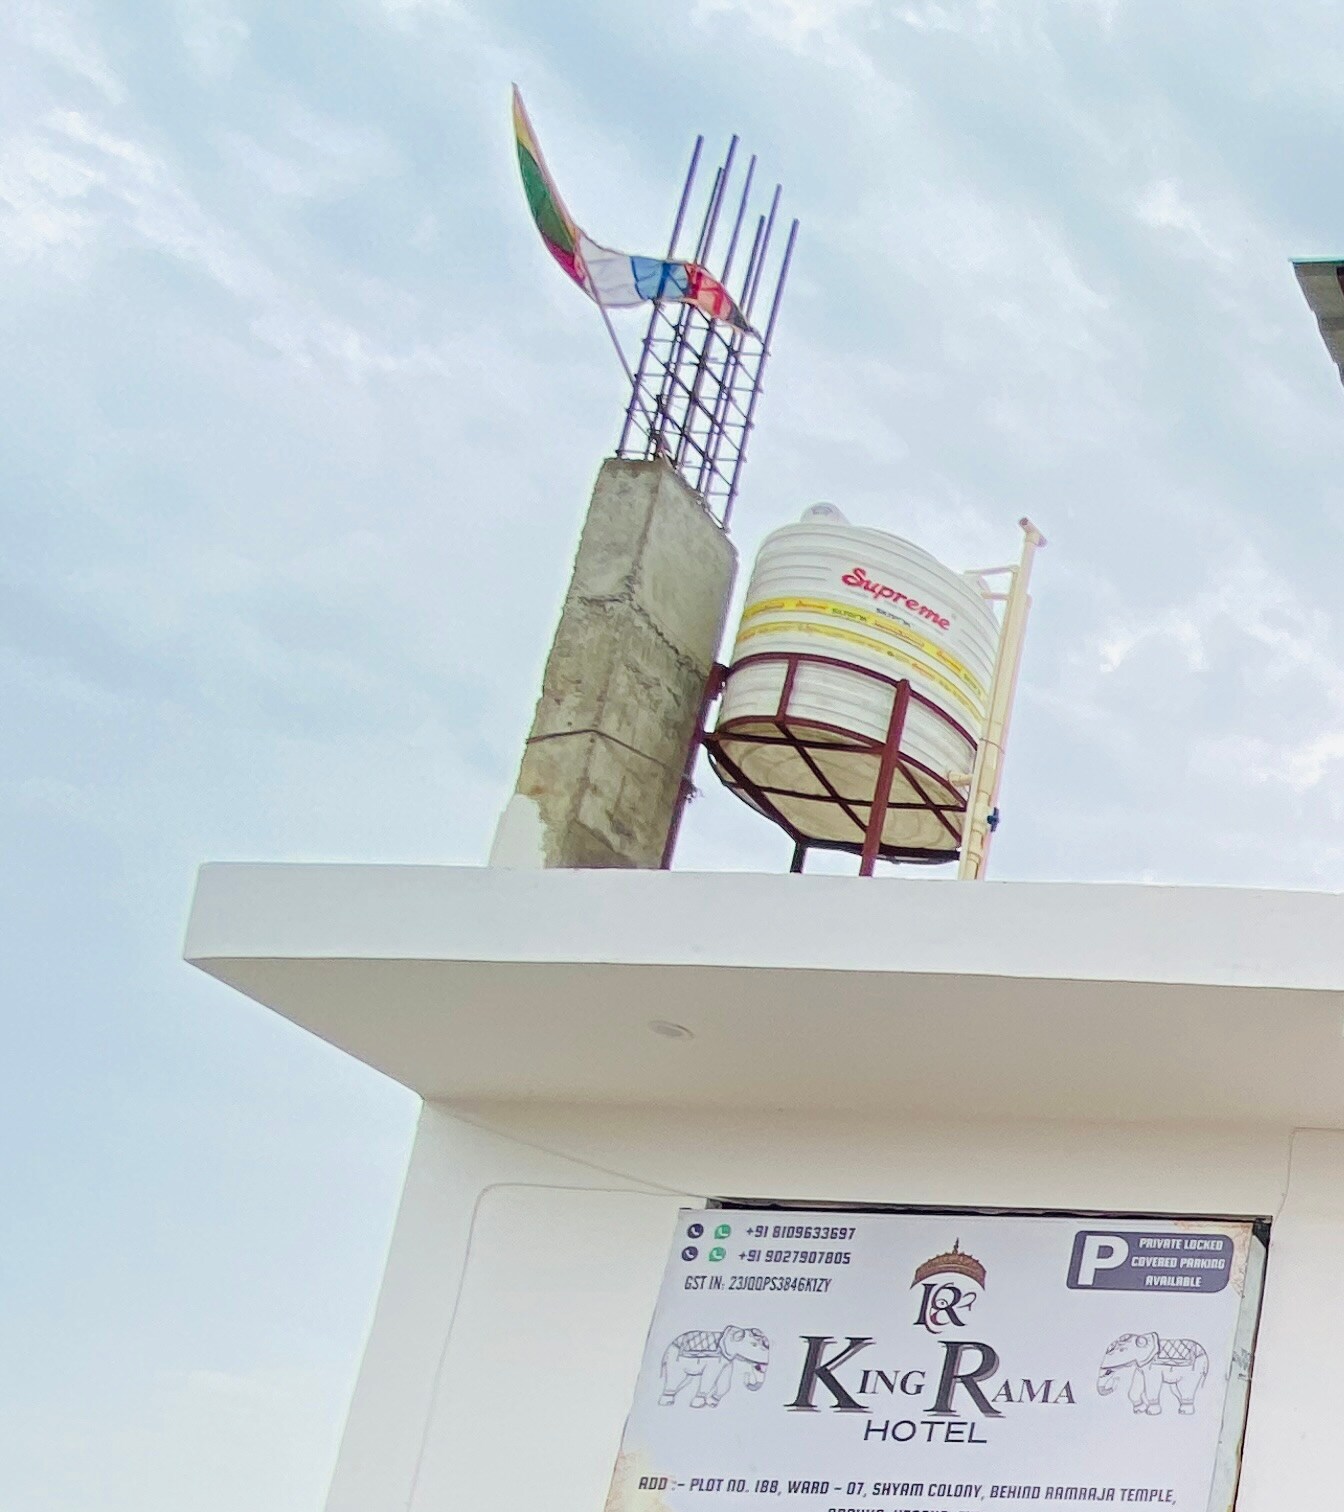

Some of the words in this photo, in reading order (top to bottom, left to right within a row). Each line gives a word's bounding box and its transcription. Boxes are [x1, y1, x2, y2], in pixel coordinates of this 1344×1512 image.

[842, 567, 950, 631] Supreme
[746, 1225, 769, 1238] +91
[772, 1225, 856, 1240] 8109633697
[1139, 1237, 1182, 1250] PRIVATE
[1183, 1239, 1224, 1251] LOCKED
[738, 1250, 761, 1262] +91
[765, 1250, 851, 1265] 9027907805
[1077, 1235, 1129, 1286] P
[1131, 1256, 1177, 1269] COVERED
[1179, 1258, 1226, 1270] PARKING
[684, 1275, 708, 1290] GST
[1145, 1275, 1202, 1288] AVAILABLE
[783, 1335, 926, 1414] KING
[923, 1340, 1077, 1418] RAMA
[863, 1419, 987, 1444] HOTEL
[638, 1477, 667, 1491] ADD
[689, 1478, 724, 1493] PLOT
[754, 1479, 782, 1497] 188,
[787, 1480, 829, 1495] WARD
[846, 1481, 867, 1498] 07,
[872, 1482, 924, 1497] SHYAM
[927, 1483, 985, 1502] COLONY,
[990, 1485, 1041, 1499] BEHIND
[1045, 1486, 1115, 1502] RAMRAJA
[1120, 1488, 1177, 1505] TEMPLE,
